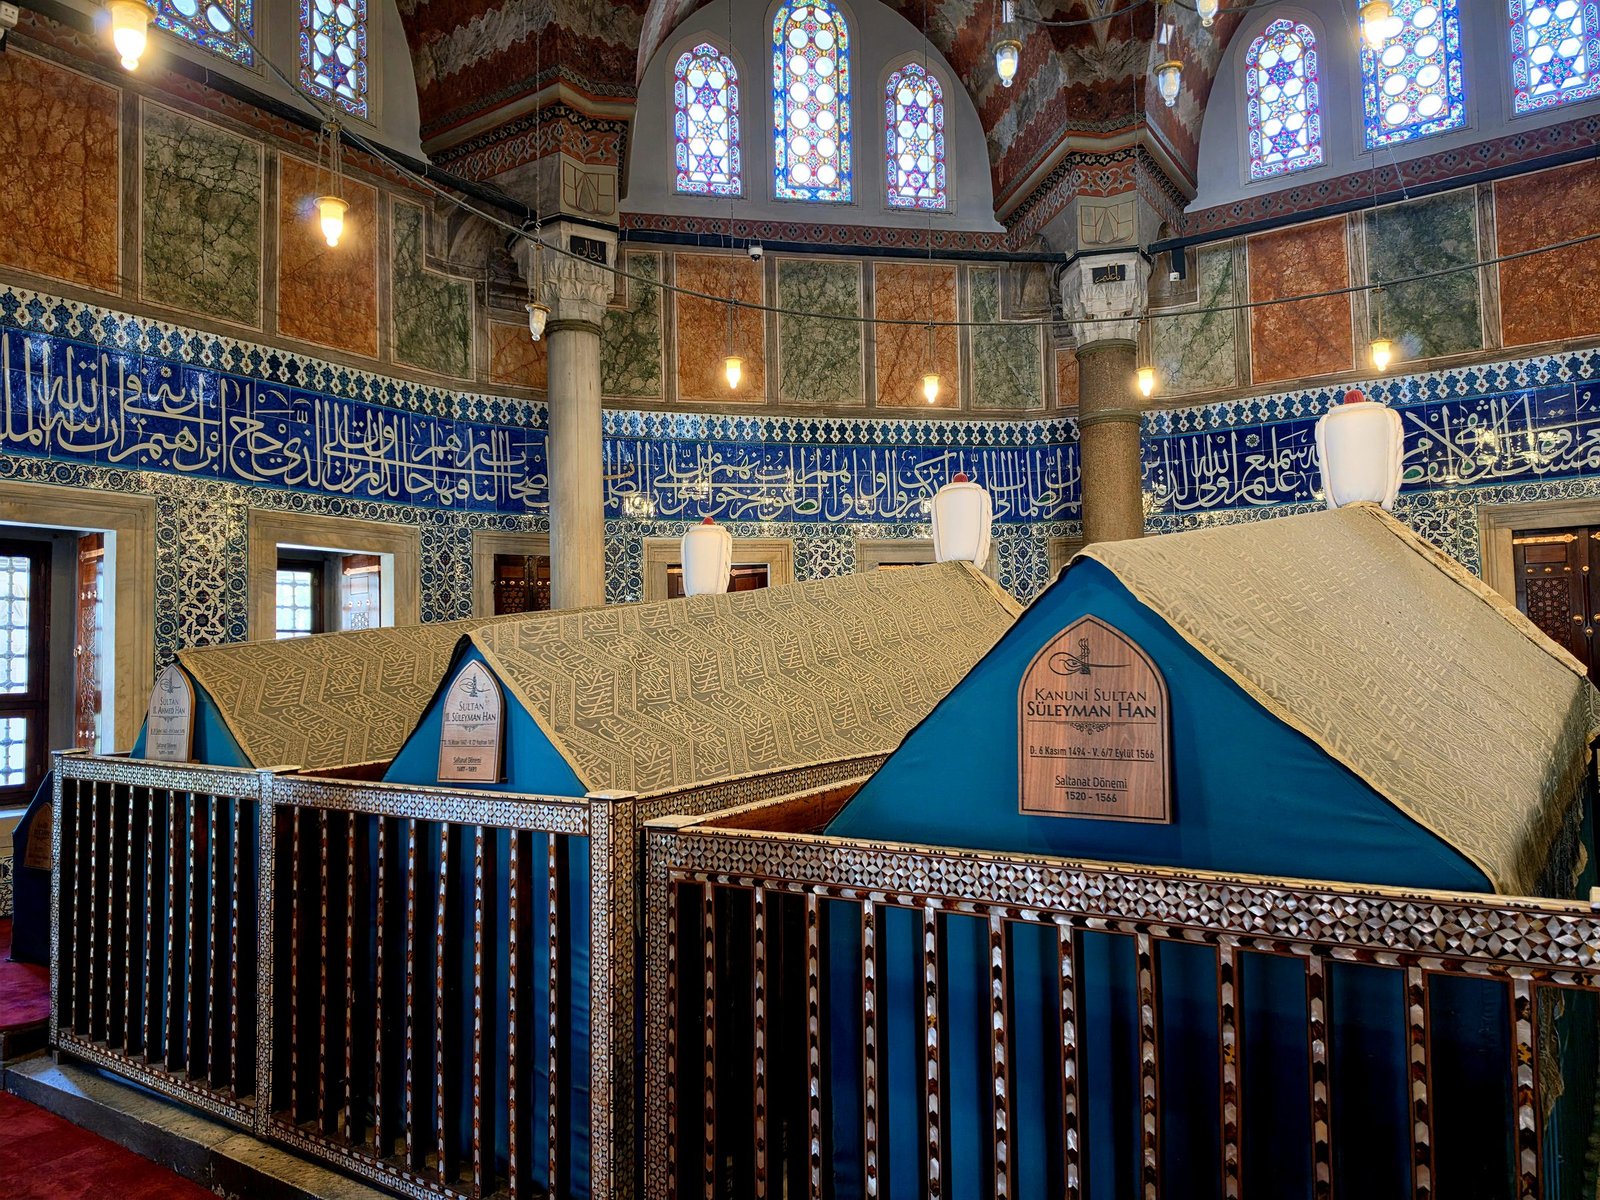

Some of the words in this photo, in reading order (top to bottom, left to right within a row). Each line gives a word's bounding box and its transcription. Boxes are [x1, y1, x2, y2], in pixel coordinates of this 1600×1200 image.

[1094, 688, 1147, 702] SULTAN
[459, 701, 484, 711] SULTAN
[1027, 701, 1111, 717] SÜLEYMAN
[1118, 702, 1157, 718] HAN
[452, 712, 481, 722] SÜLEYMAN
[482, 712, 496, 722] HAN
[1038, 746, 1044, 755] 6
[1045, 746, 1067, 756] Kasım
[1068, 747, 1086, 757] 1494
[1092, 748, 1099, 757] V.
[1101, 748, 1113, 758] 6/7
[1115, 748, 1134, 759] Eylül
[1136, 749, 1155, 759] 1566
[1055, 775, 1090, 787] Saltanat
[1092, 777, 1128, 789] Dönemi
[1065, 791, 1086, 801] 1520
[1095, 793, 1117, 803] 1566
